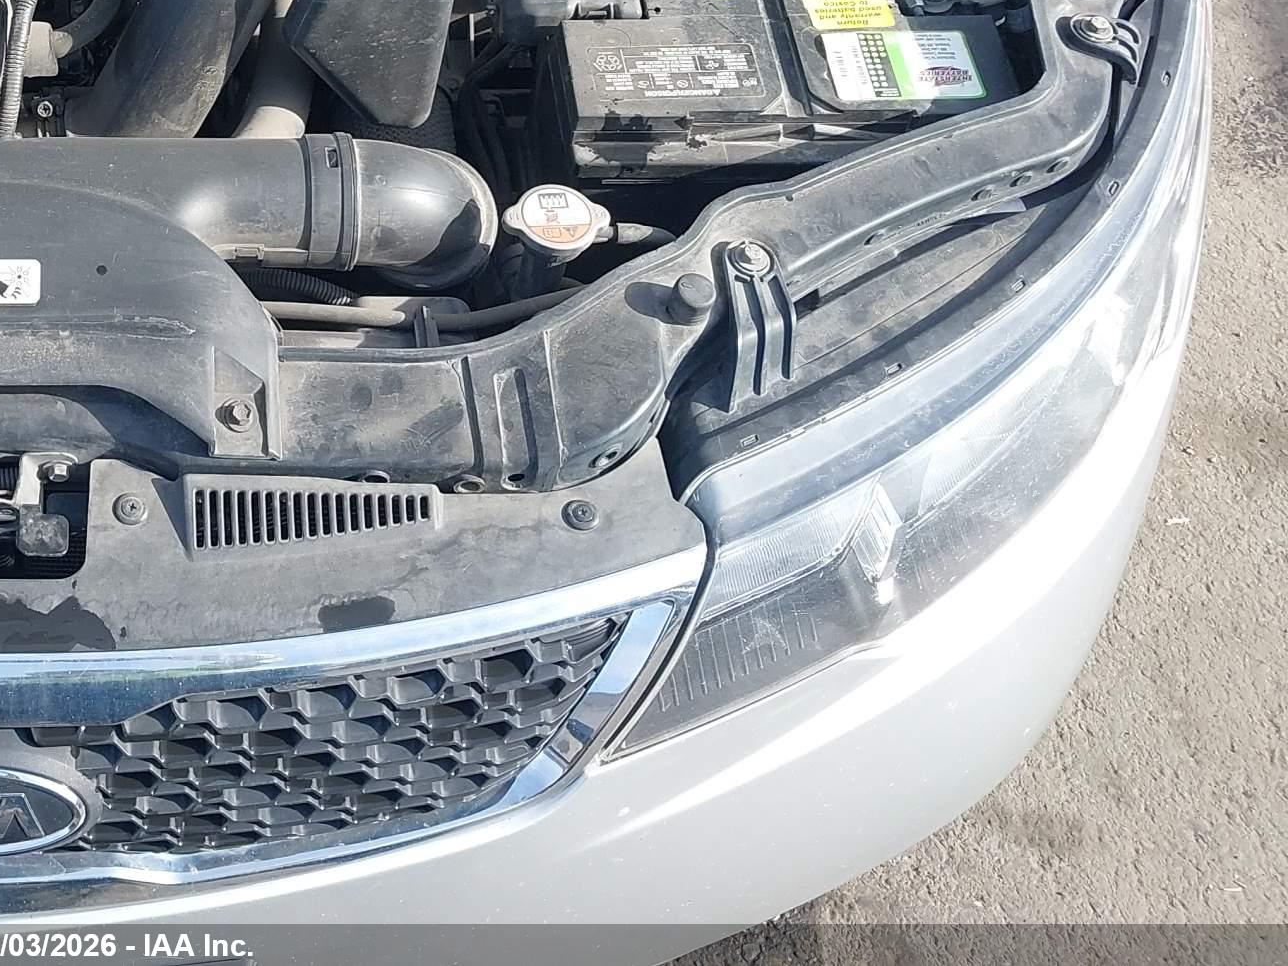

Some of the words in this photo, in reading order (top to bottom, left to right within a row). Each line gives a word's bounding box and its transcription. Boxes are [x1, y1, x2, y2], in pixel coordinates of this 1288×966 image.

[823, 0, 857, 8] Costco
[814, 6, 856, 15] batteries
[858, 5, 882, 13] used
[818, 13, 836, 21] and
[839, 11, 881, 20] warranty
[836, 18, 869, 26] Return
[919, 68, 969, 76] BATTERIES
[916, 75, 972, 83] INTERSTATE
